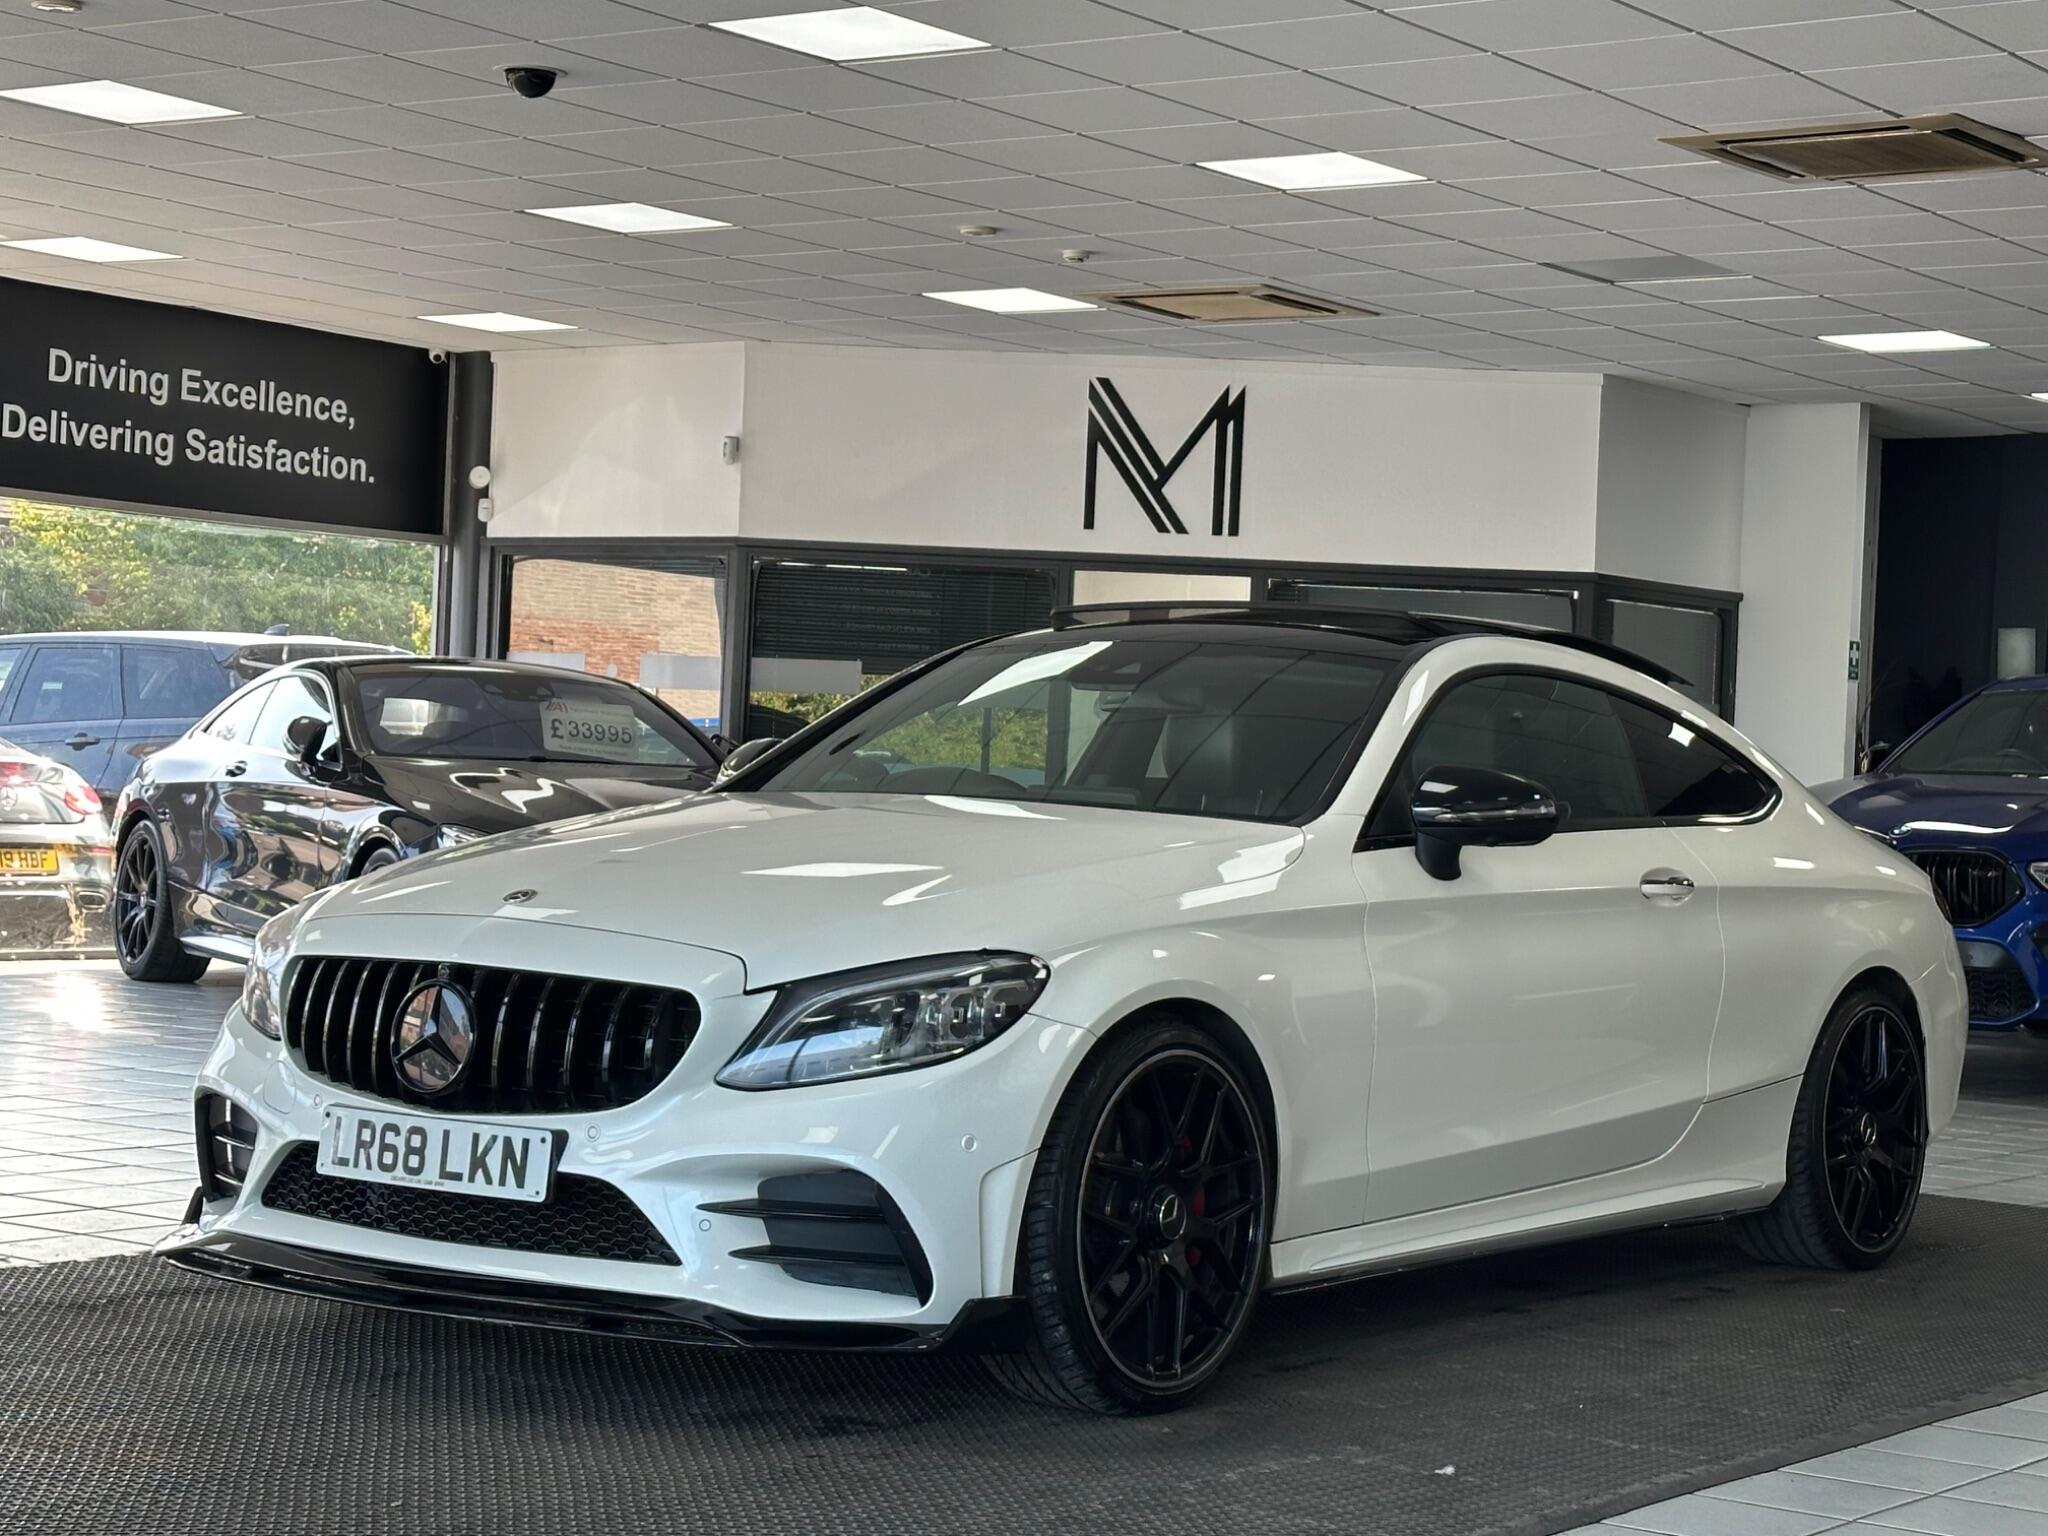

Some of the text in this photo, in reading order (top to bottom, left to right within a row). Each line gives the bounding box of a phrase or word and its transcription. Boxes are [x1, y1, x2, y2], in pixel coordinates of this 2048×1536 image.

[48, 347, 355, 430] Driving Excellence,
[1, 403, 375, 483] Delivering Satisfaction.
[18, 851, 48, 868] HBF
[331, 1115, 530, 1189] LR68 LKN
